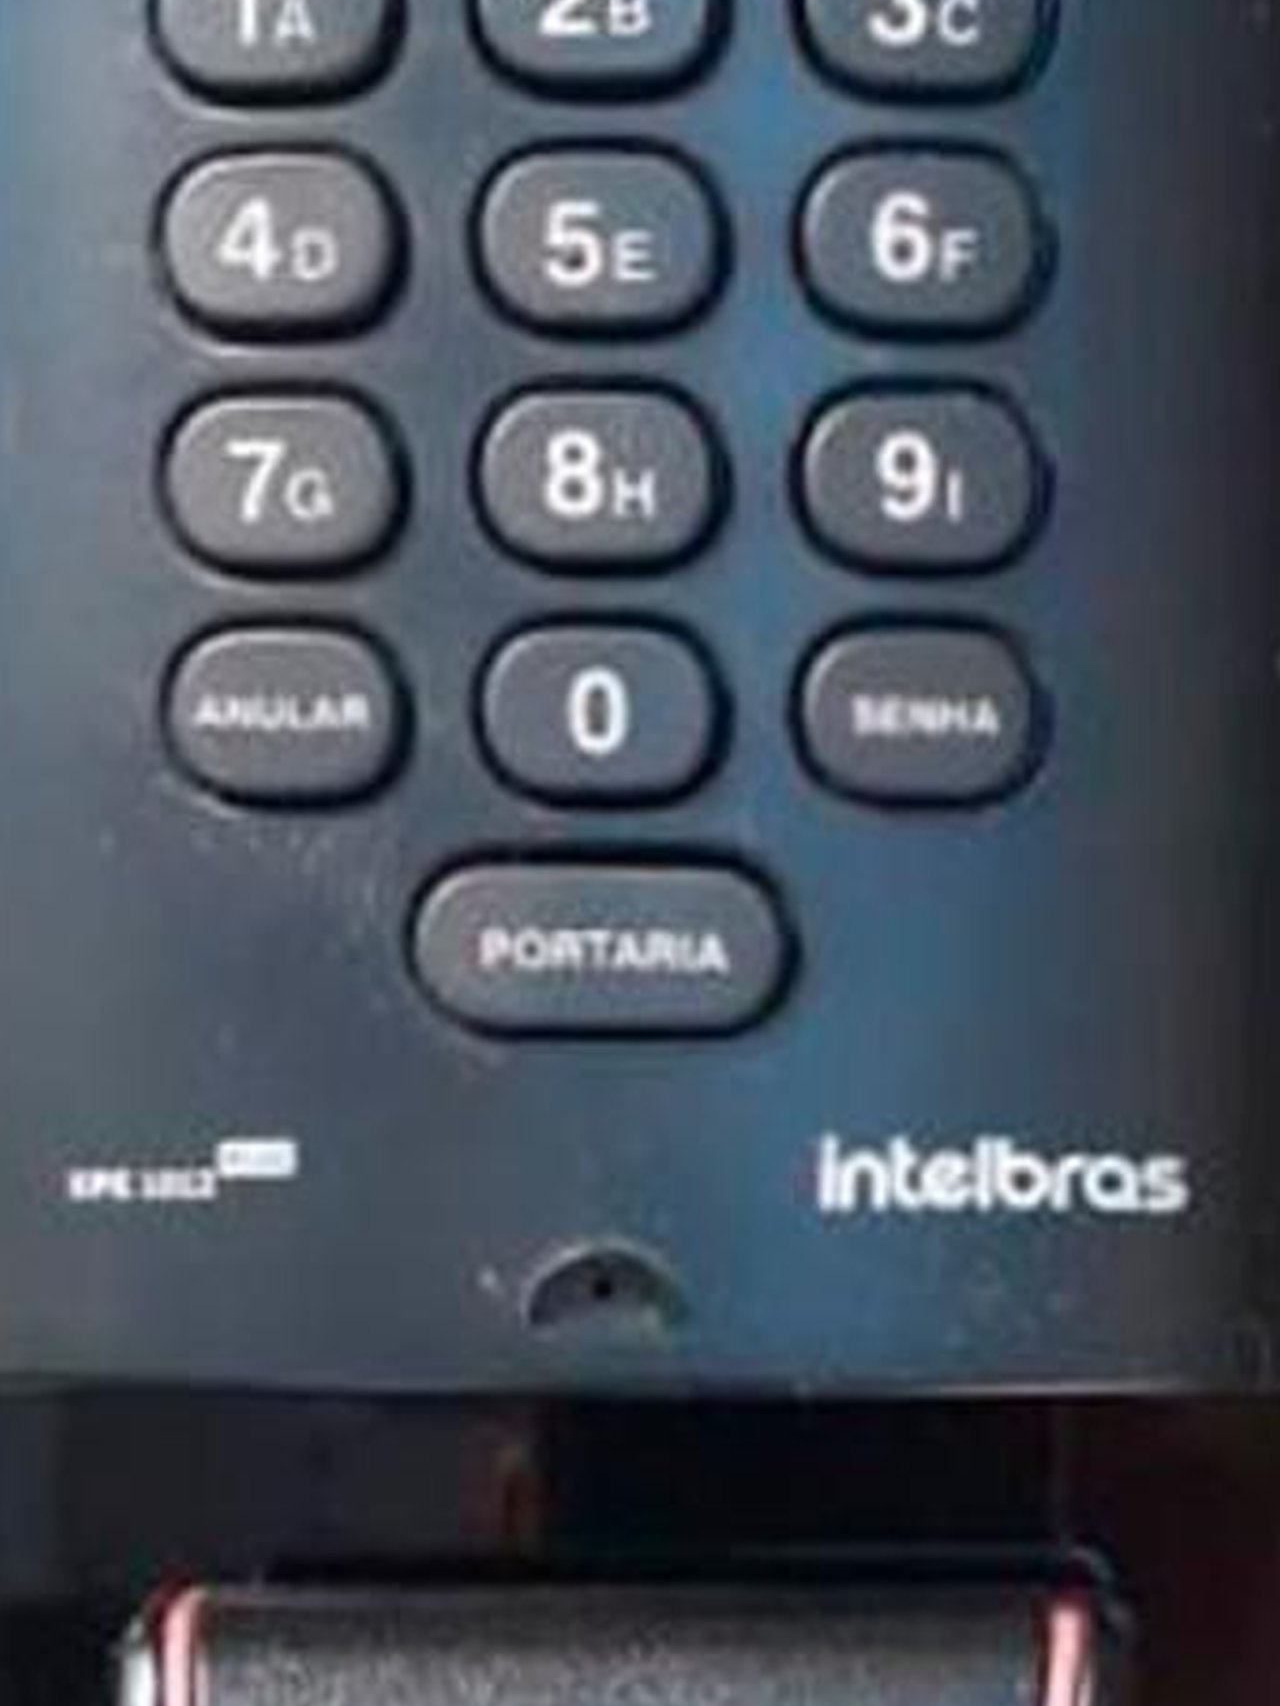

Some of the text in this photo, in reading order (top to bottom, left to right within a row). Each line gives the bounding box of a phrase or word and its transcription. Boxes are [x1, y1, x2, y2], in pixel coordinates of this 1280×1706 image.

[190, 692, 370, 732] ANULAR
[566, 666, 629, 756] 0
[850, 693, 1000, 736] SENHA
[478, 925, 730, 973] PORTARIA
[815, 1132, 1188, 1213] intelbras
